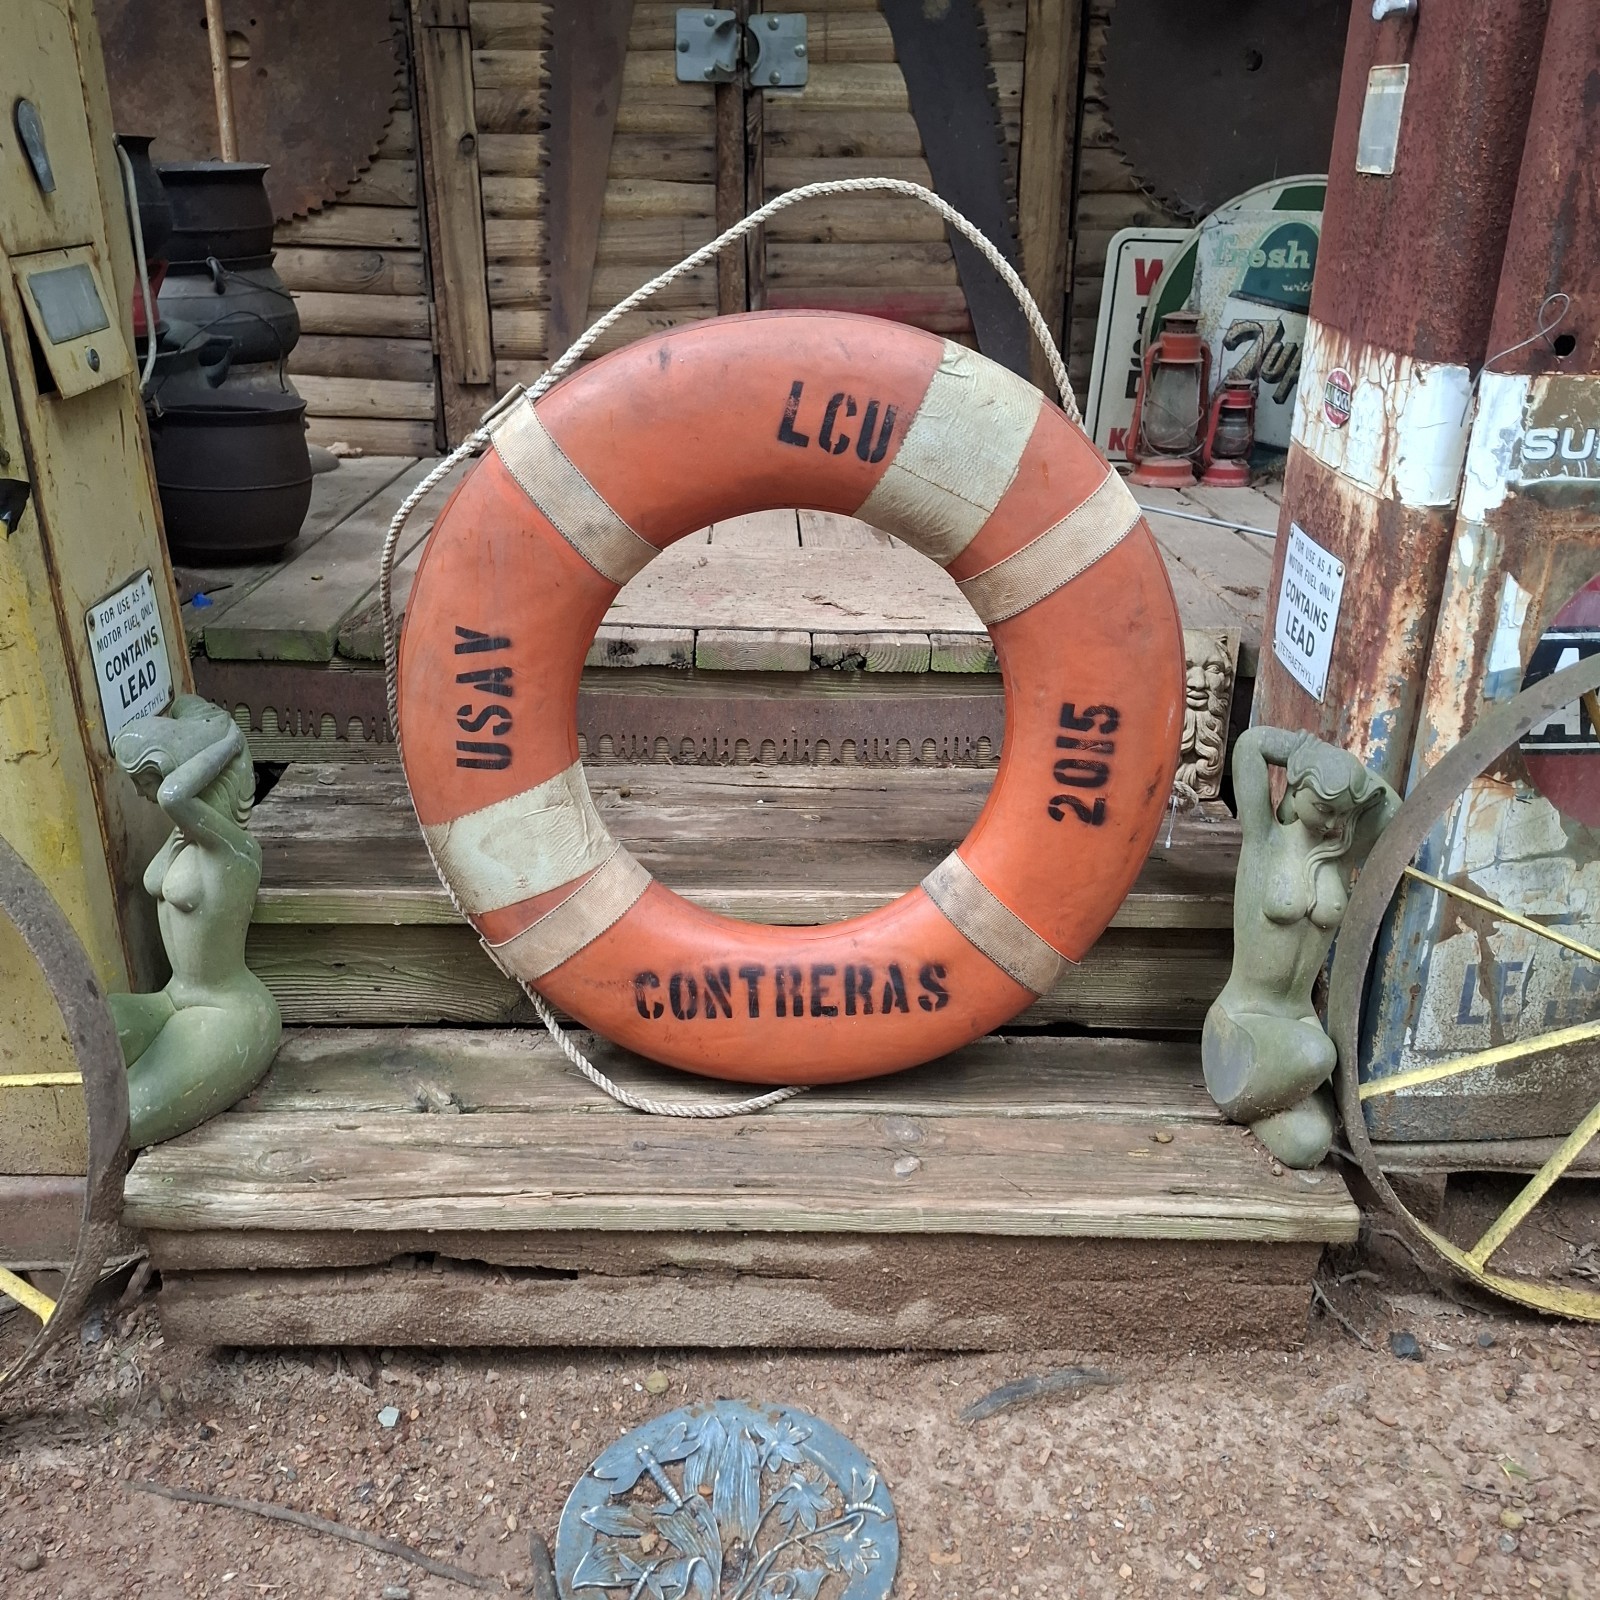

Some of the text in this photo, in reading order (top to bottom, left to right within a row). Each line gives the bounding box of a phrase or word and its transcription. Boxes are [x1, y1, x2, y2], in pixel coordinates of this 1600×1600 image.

[1282, 281, 1313, 292] wit
[777, 380, 898, 463] LCU
[1523, 427, 1600, 459] SU
[1289, 553, 1336, 603] MOTOR FUEL ONLY
[1295, 537, 1331, 578] FOR USE AS A
[97, 600, 154, 653] MOTOR FUEL ONLY
[100, 584, 146, 627] FOR USE AS A
[1285, 578, 1328, 632] CONTAINS
[105, 625, 159, 682] CONTAINS
[1285, 610, 1315, 657] LEAD
[119, 660, 157, 709] LEAD
[1048, 702, 1119, 826] 2015
[632, 963, 950, 1020] CONTRERAS
